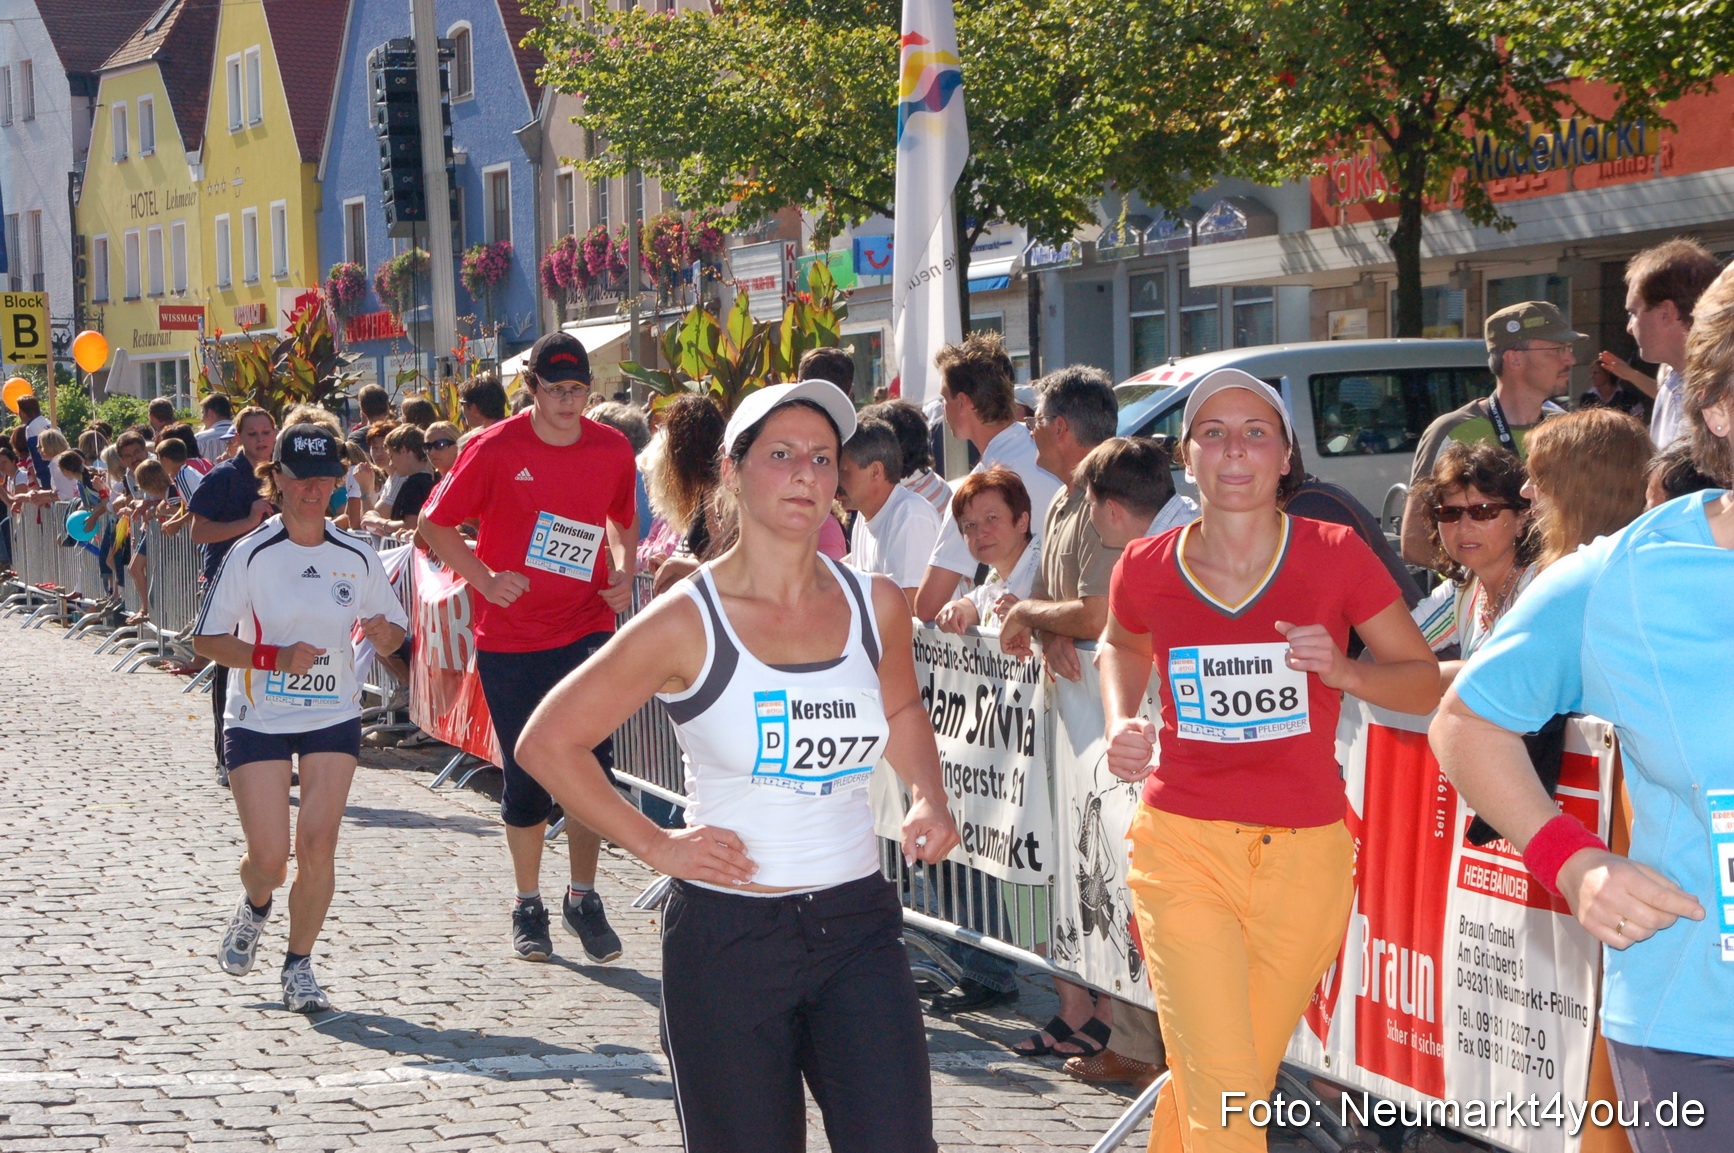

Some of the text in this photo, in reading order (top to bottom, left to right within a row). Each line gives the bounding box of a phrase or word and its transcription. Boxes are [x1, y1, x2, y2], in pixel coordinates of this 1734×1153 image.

[1322, 141, 1399, 205] Takk
[130, 187, 197, 219] HOTEL Lehmeier
[785, 244, 797, 306] KIN
[4, 295, 43, 308] Block
[13, 314, 39, 348] B
[133, 329, 172, 348] Restaurant
[536, 532, 544, 542] D
[546, 540, 593, 564] 2727
[552, 522, 595, 541] Christian
[313, 655, 330, 665] ard
[913, 637, 1041, 684] thopädie-Schuhtechnik
[1203, 656, 1273, 677] Kathrin
[287, 673, 336, 692] 2200
[791, 699, 857, 720] Kerstin
[921, 672, 1036, 757] dam Silvia
[1180, 684, 1299, 717] D 3068
[1258, 719, 1307, 734] PFLEIDERER
[767, 731, 880, 769] D 2977
[1010, 767, 1025, 807] 21
[1434, 808, 1446, 838] Seit
[1463, 863, 1529, 901] HEBEBÄNDER
[1459, 914, 1515, 949] Braun GmbH
[1355, 913, 1435, 1024] Braun
[1457, 941, 1524, 982] Am Grünberg 8
[1457, 967, 1589, 1028] D-92318 Neumarkt-Pölling
[1386, 1018, 1409, 1046] Sicher
[1457, 1005, 1474, 1029] Tel.
[1476, 1011, 1503, 1038] 09181
[1510, 1024, 1546, 1051] 2307-0
[1458, 1031, 1474, 1054] Fax
[1477, 1038, 1503, 1065] 09181
[1511, 1051, 1555, 1080] 2307-70
